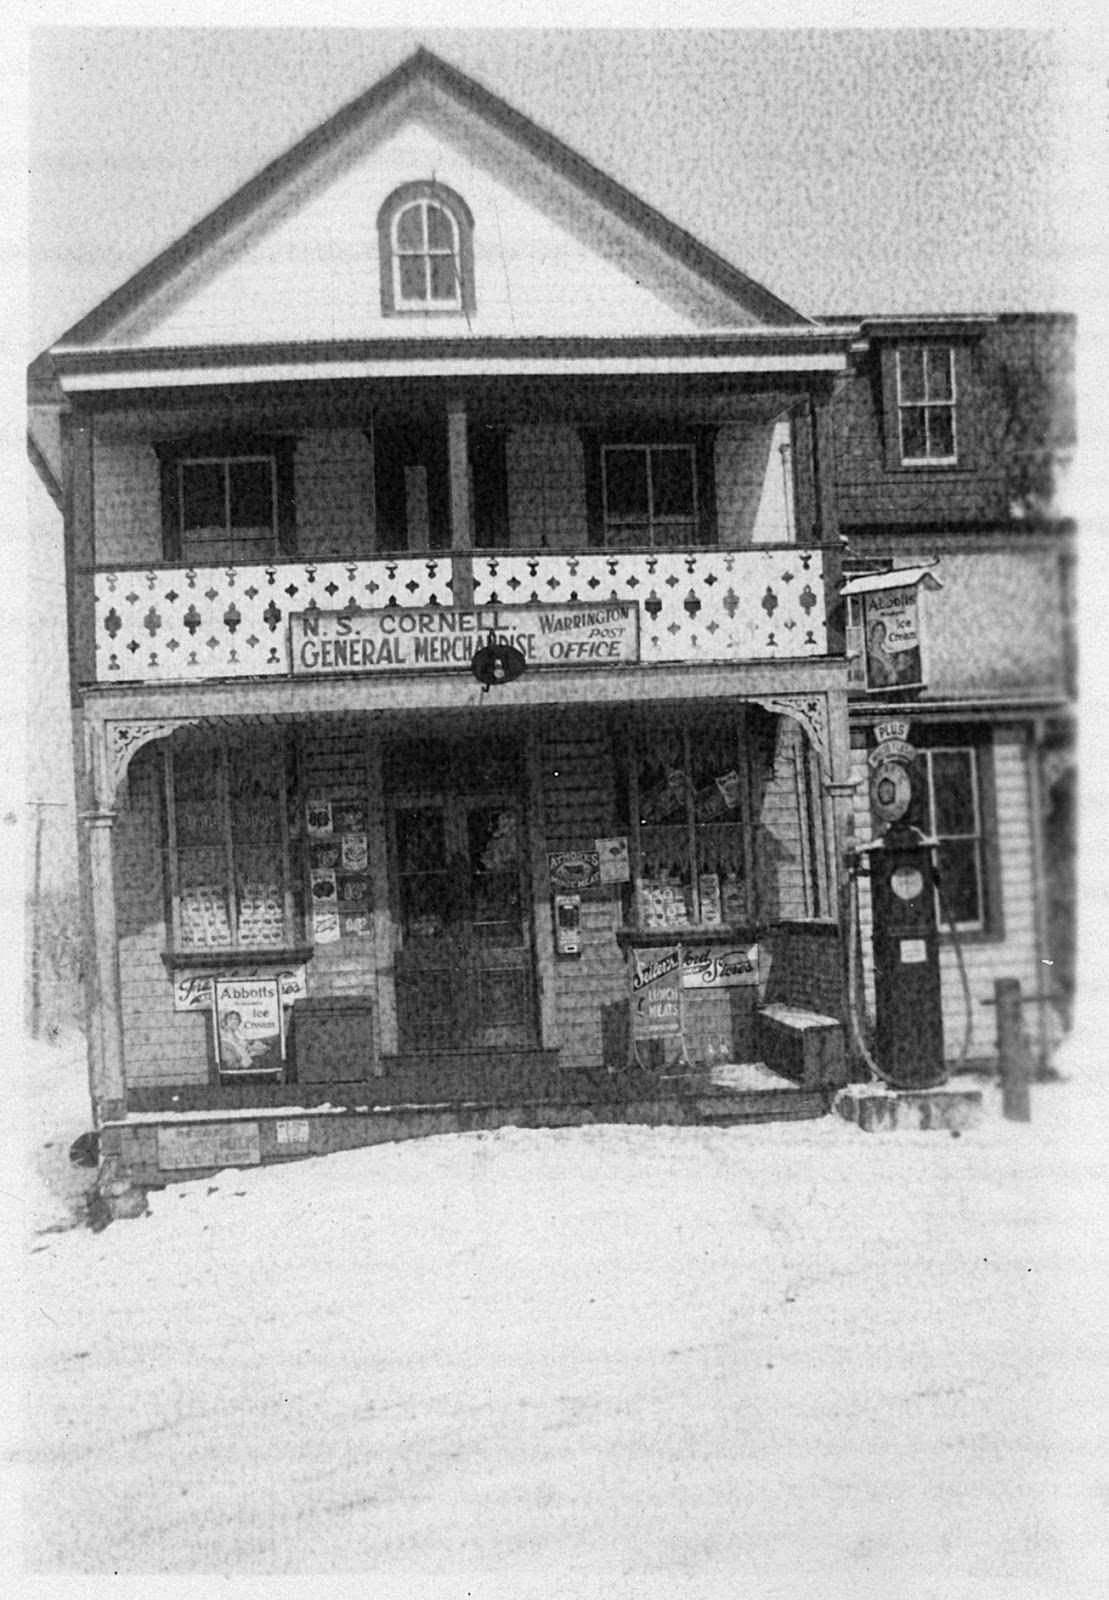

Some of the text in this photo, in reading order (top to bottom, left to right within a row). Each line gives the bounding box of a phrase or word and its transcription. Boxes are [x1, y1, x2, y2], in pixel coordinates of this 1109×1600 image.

[303, 617, 328, 637] N.
[336, 615, 361, 637] S.
[538, 607, 630, 635] WARRINGTON
[896, 619, 912, 629] Ice
[587, 627, 627, 639] POST
[300, 637, 406, 668] GENERAL
[550, 641, 622, 659] OFFICE
[878, 724, 905, 739] PLUS
[702, 951, 754, 983] Stores
[648, 988, 678, 1001] LUNCH
[253, 1009, 270, 1018] Ice
[649, 1003, 679, 1018] MEATS
[244, 1020, 275, 1030] Cream
